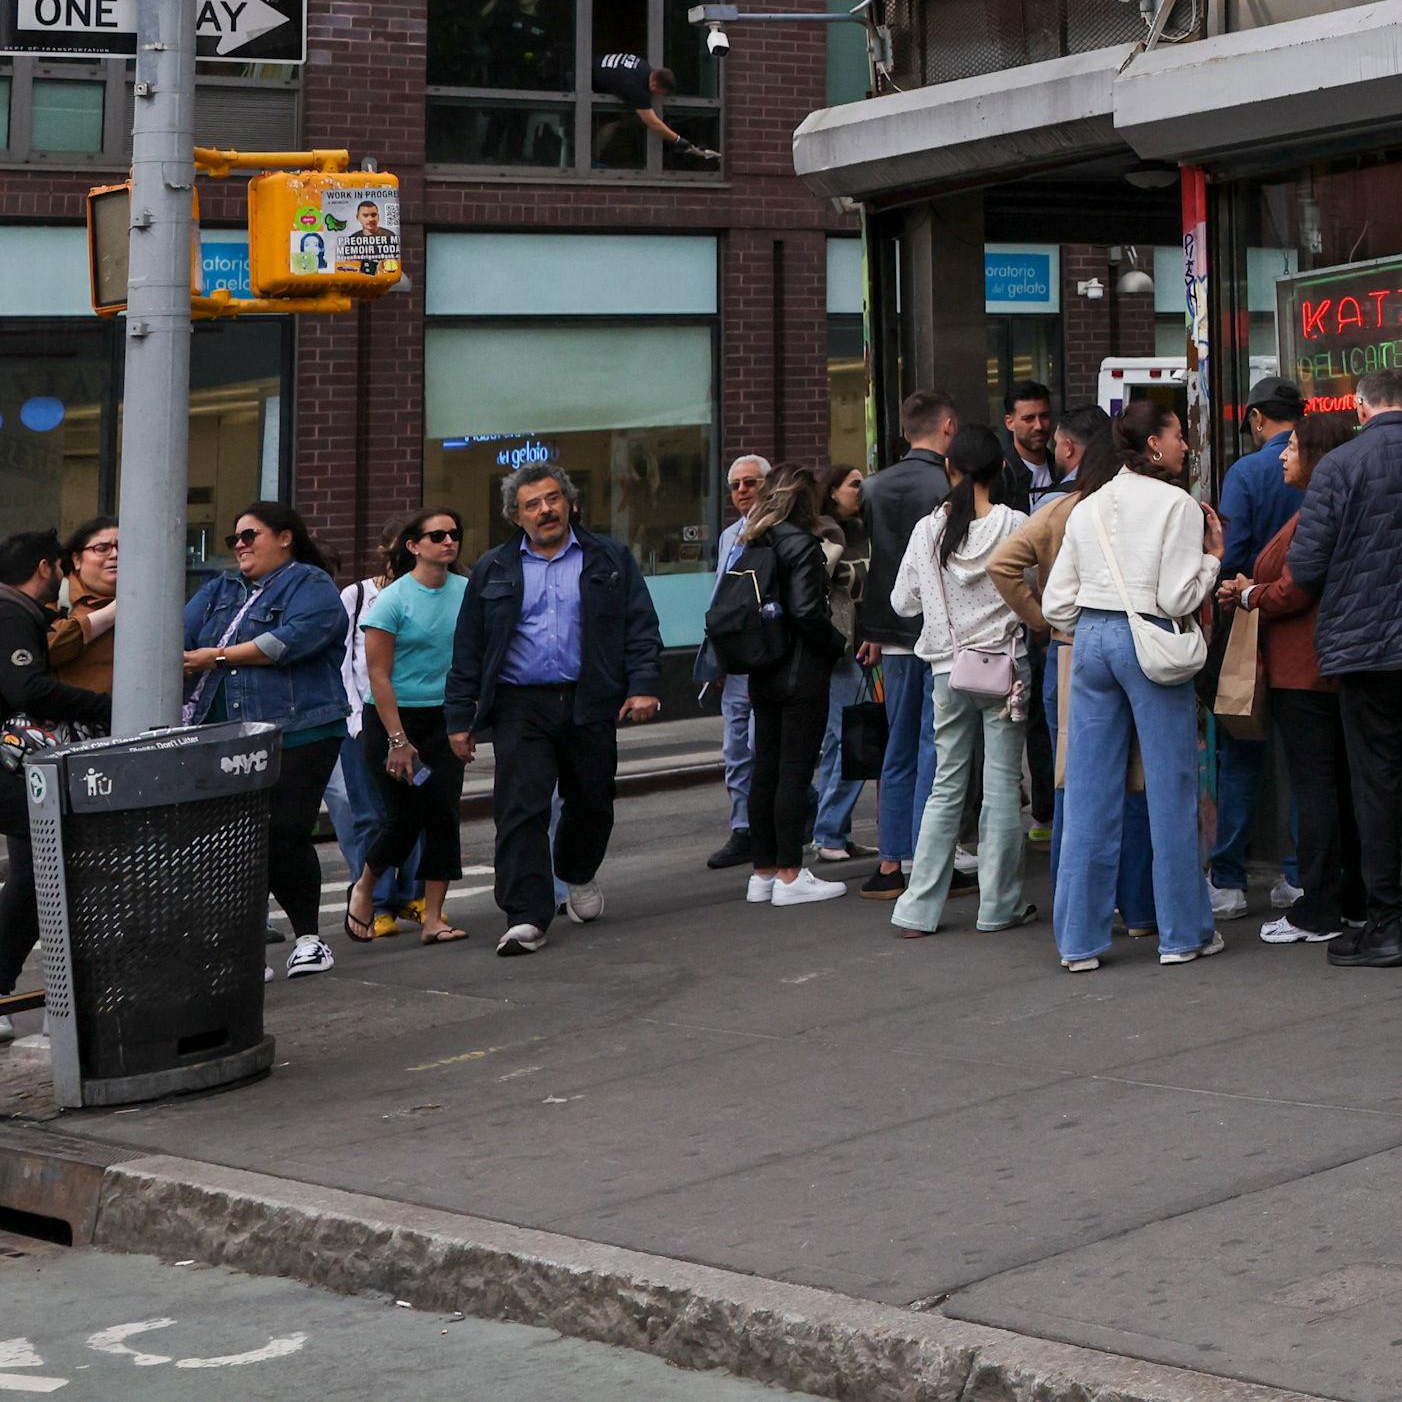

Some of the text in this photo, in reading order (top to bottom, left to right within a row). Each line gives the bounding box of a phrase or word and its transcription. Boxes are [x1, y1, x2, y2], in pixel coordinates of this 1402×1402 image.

[197, 0, 248, 33] AY
[326, 191, 352, 200] WORK
[354, 191, 363, 199] IN
[337, 236, 389, 246] PREORDER
[336, 245, 375, 256] MEMOIR
[1007, 278, 1047, 299] gelato
[156, 739, 178, 750] Don't
[179, 734, 200, 747] Litter
